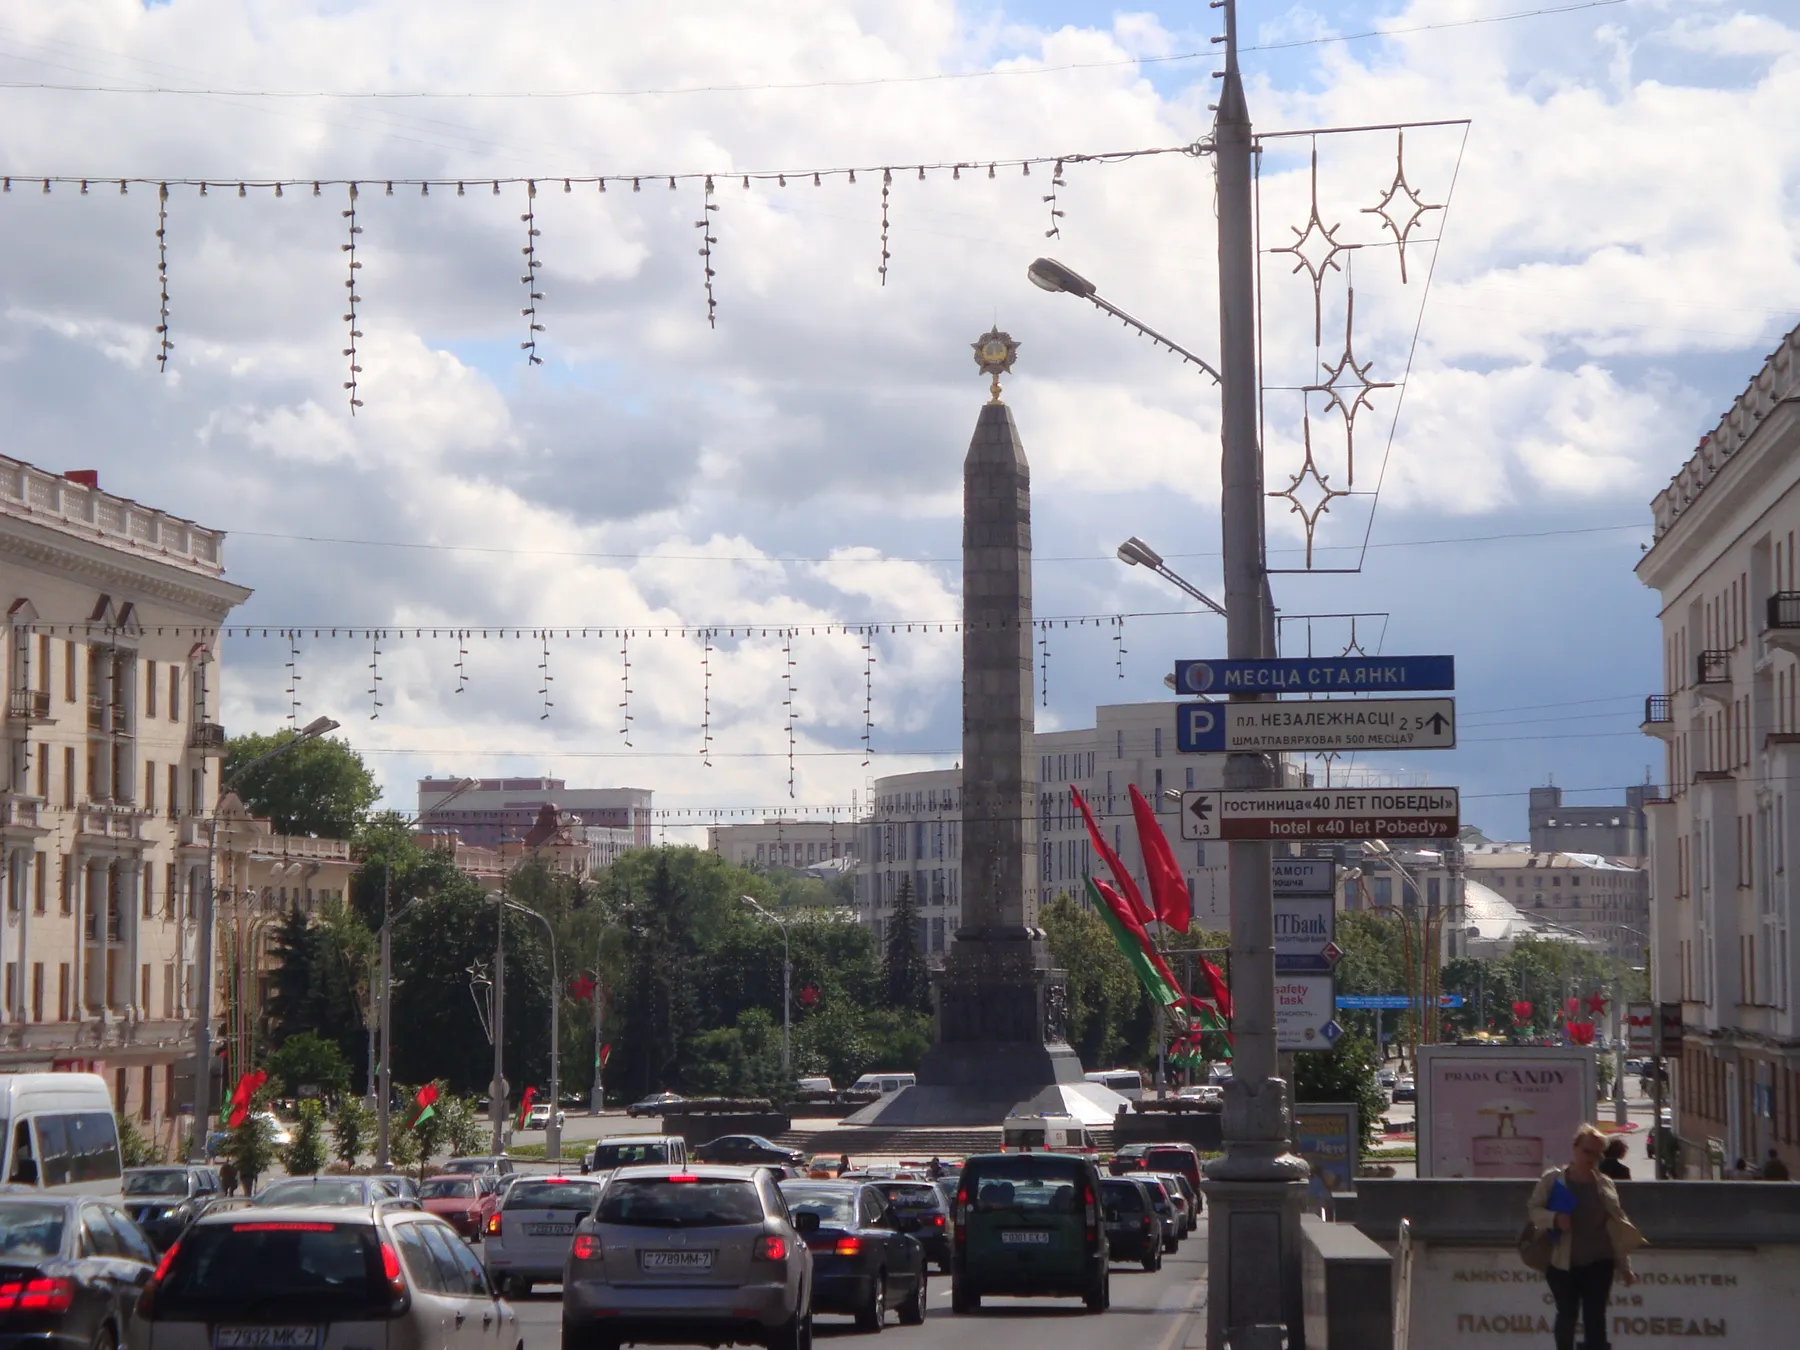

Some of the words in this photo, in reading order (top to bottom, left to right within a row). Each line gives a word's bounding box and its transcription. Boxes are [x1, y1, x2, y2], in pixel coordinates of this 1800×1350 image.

[1224, 669, 1301, 687] МЕСЦА
[1307, 667, 1406, 685] СТАЯНКІ
[1261, 711, 1395, 728] НЕЗАЛЕЖНАСЦІ
[1189, 710, 1215, 746] P
[1232, 734, 1342, 746] ШМАТПАВЯРХОВАЯ
[1345, 734, 1365, 745] 500
[1368, 733, 1414, 744] МЕСЦАЎ
[1334, 796, 1366, 810] ЛЕТ
[1371, 795, 1453, 811] ПОБЕДЫ»
[1269, 821, 1311, 835] hotel
[1316, 821, 1345, 834] «40
[1350, 820, 1371, 834] let
[1375, 820, 1448, 836] Pobedy»
[1273, 866, 1313, 876] АМОГІ
[1275, 984, 1309, 997] safety
[1280, 995, 1304, 1005] task
[1444, 1071, 1490, 1082] PRADA
[1494, 1069, 1568, 1085] CANDY
[1612, 1315, 1728, 1337] ПОБЕДЫ
